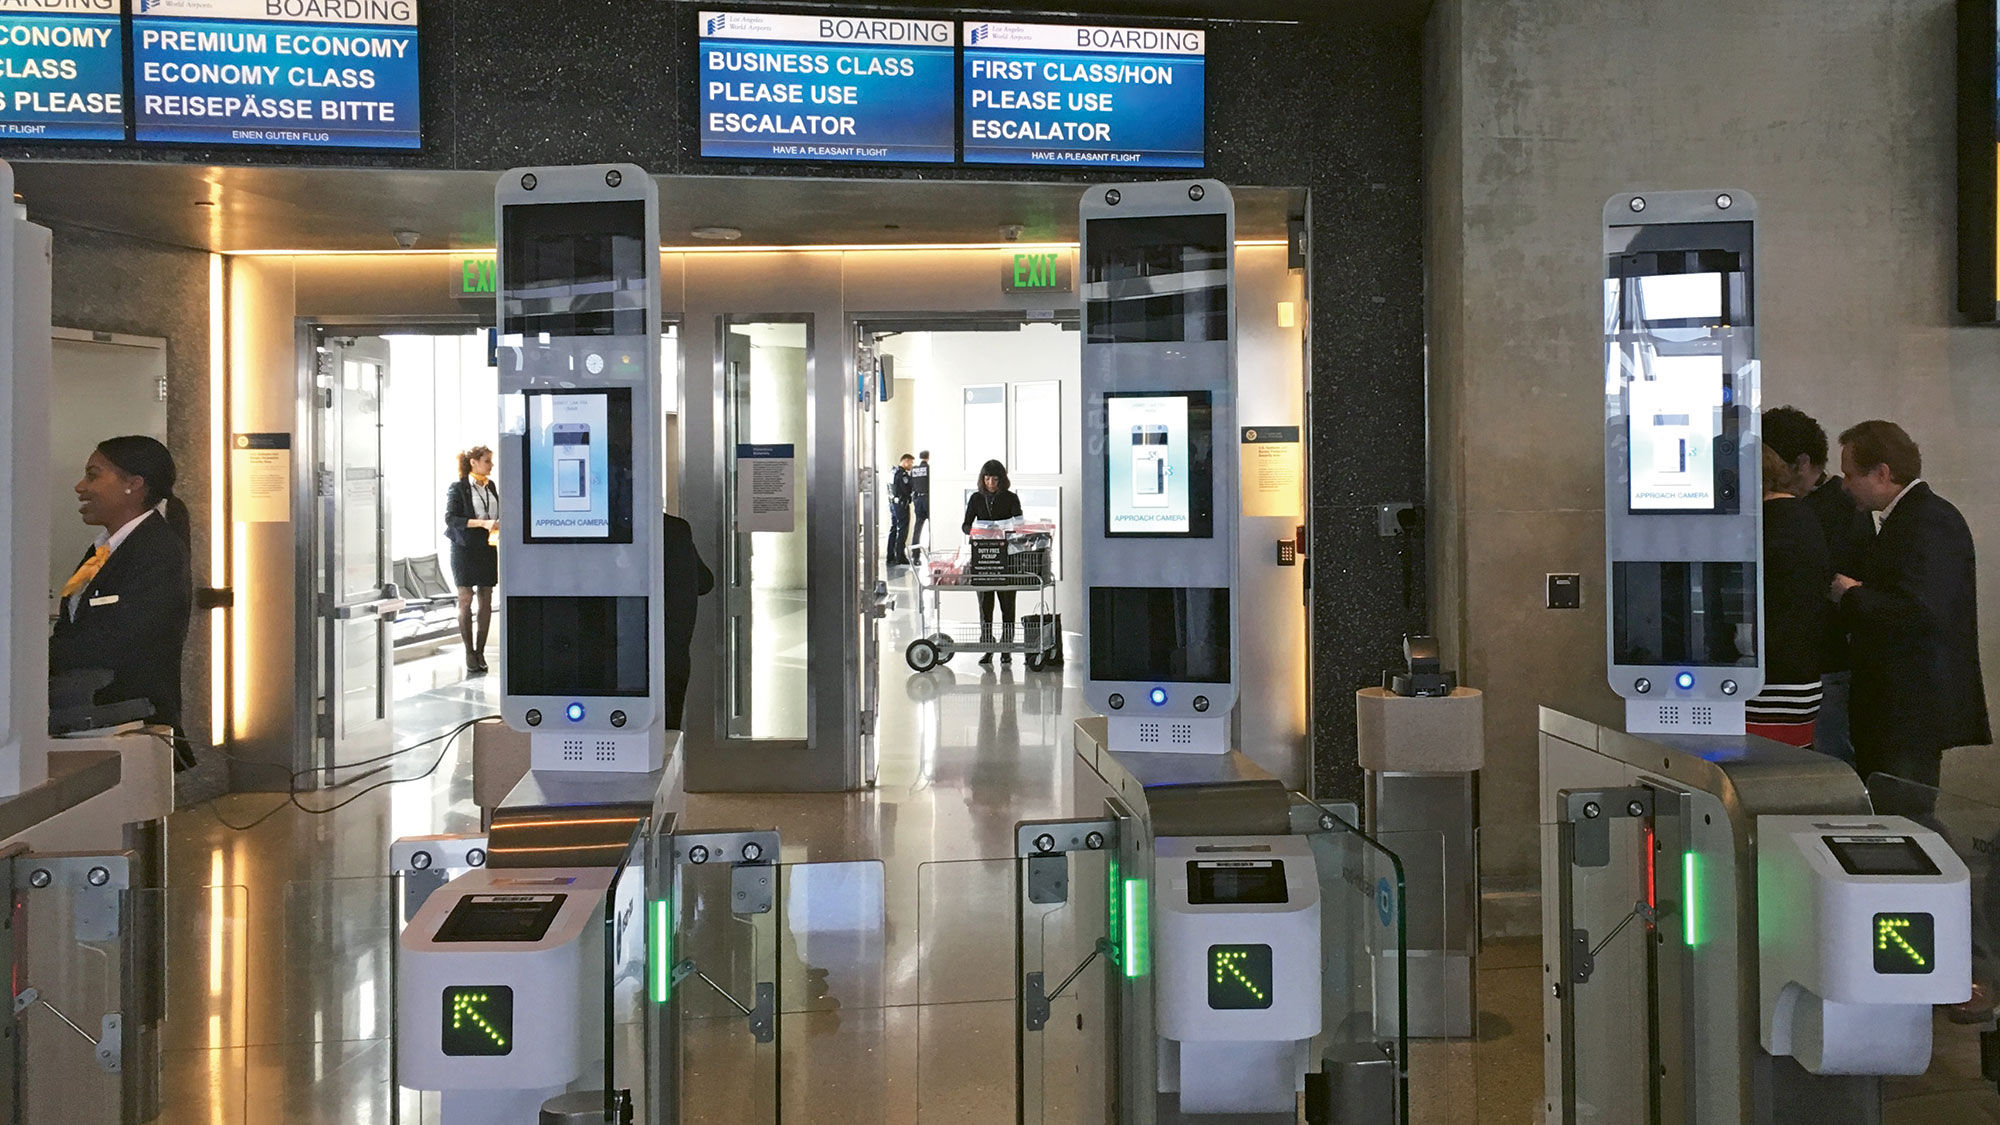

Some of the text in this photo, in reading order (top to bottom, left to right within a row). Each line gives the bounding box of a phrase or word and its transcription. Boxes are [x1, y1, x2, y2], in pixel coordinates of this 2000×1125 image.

[266, 0, 410, 21] BOARDING
[820, 19, 948, 42] BOARDING
[1077, 28, 1199, 51] BOARDING
[143, 29, 410, 58] PREMIUM ECONOMY
[0, 58, 77, 80] LASS
[144, 62, 375, 89] ECONOMY CLASS
[708, 51, 914, 77] BUSINESS CLASS
[972, 60, 1173, 85] FIRST CLASS/HON
[14, 91, 122, 114] PLEASE
[709, 82, 858, 105] PLEASE USE
[972, 89, 1113, 112] PLEASE USE
[145, 94, 395, 122] REISEPÄSSE BITTE
[9, 124, 46, 134] FLIGHT
[709, 112, 856, 136] ESCALATOR
[972, 119, 1111, 142] ESCALATOR
[232, 130, 329, 142] EINEN GUTEN FLUG
[772, 146, 888, 157] HAVE A PLEASANT FLIGHT
[1031, 151, 1141, 163] HAVE A PLEASANT FLIGHT
[462, 259, 496, 293] EXI
[1013, 253, 1058, 288] EXIT
[535, 518, 609, 527] APPROACH CAMERA
[1114, 514, 1186, 522] APPROACH CAMERA
